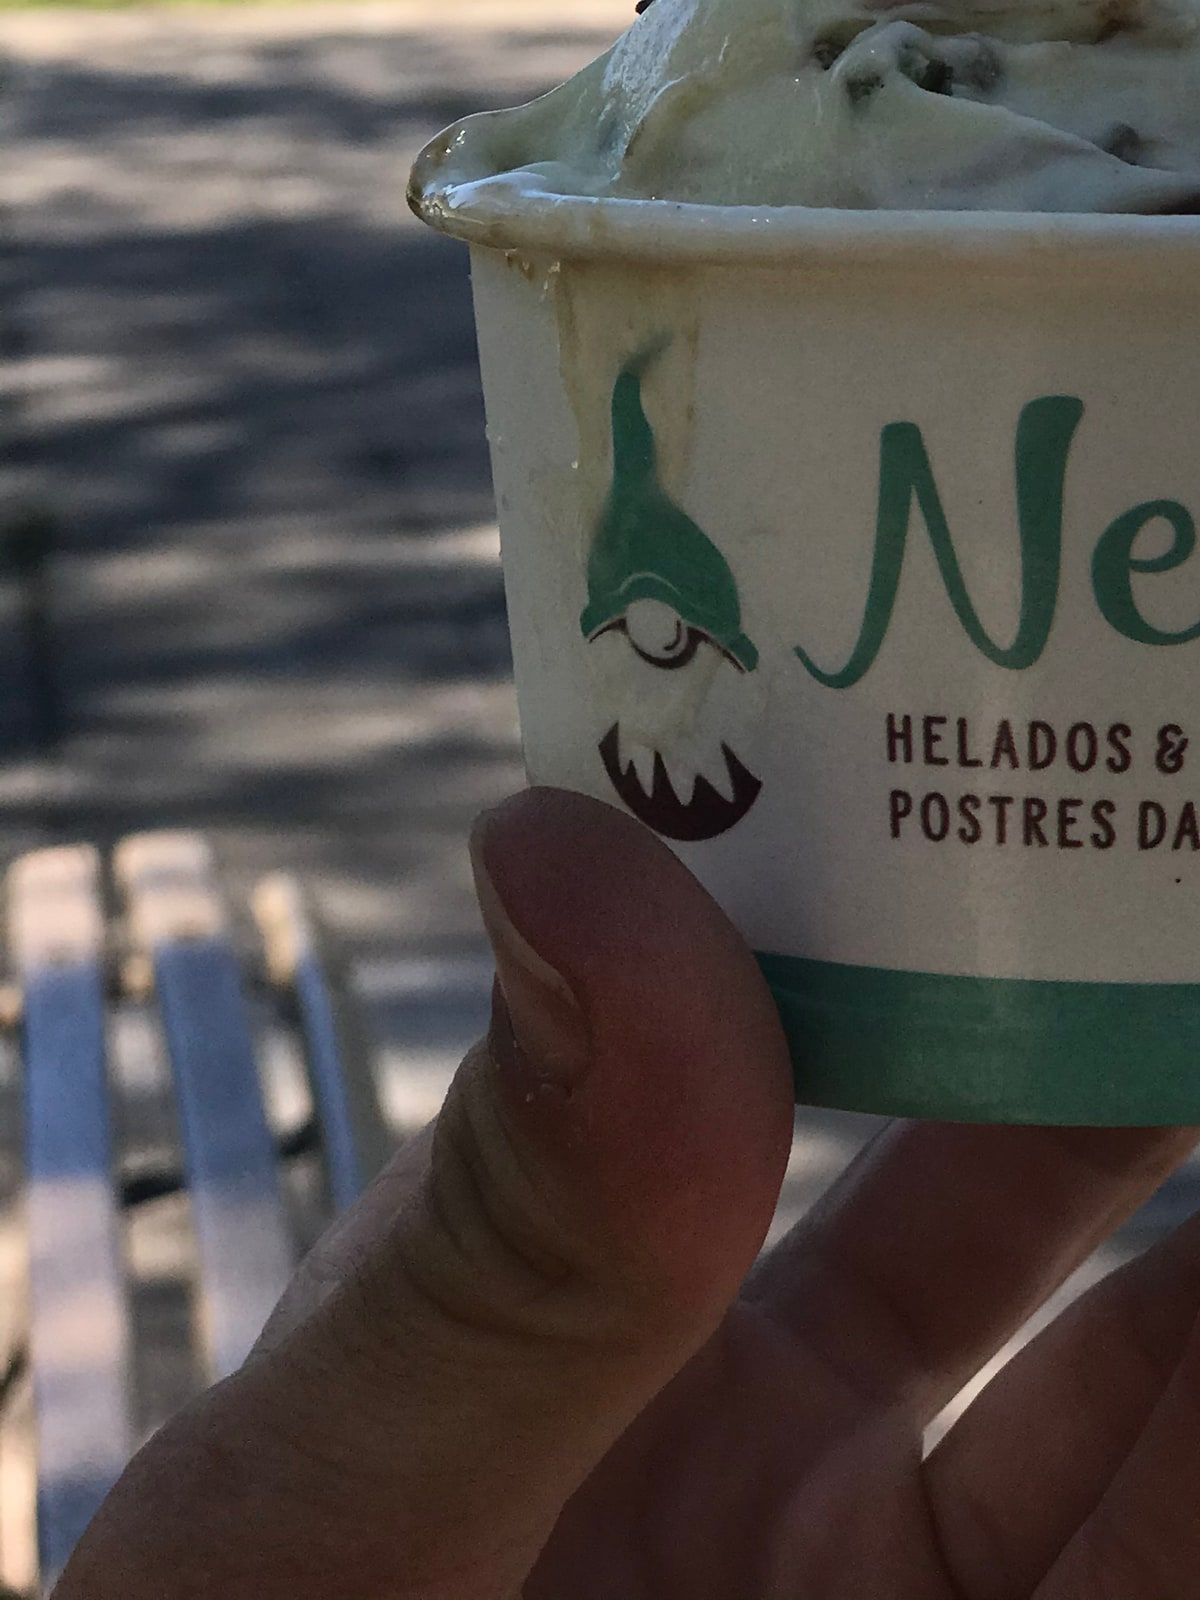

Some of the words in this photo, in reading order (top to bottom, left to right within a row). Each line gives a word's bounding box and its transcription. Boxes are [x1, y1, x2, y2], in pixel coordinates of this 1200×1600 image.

[884, 711, 1134, 775] HELADOS
[1153, 722, 1191, 776] &
[887, 788, 1118, 851] POSTRES
